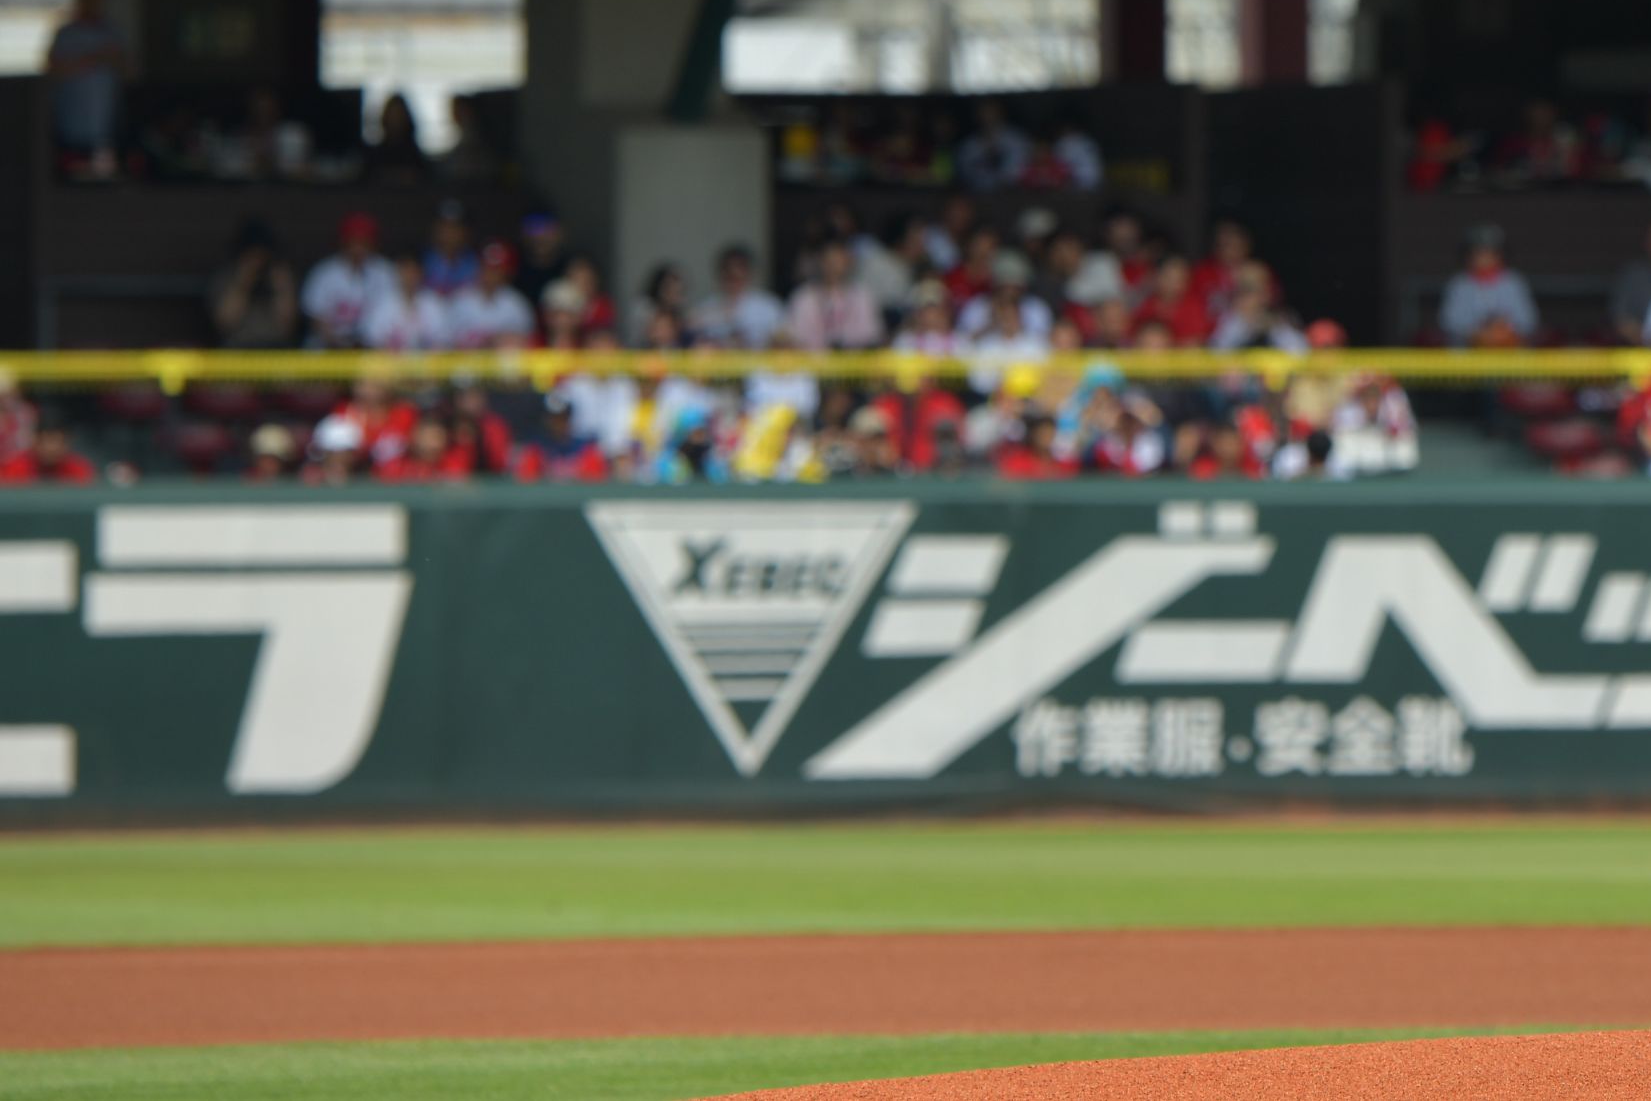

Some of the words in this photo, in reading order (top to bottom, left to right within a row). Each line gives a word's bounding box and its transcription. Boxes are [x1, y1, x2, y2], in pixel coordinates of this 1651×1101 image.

[1012, 695, 1474, 778] 作業服・安全靴
